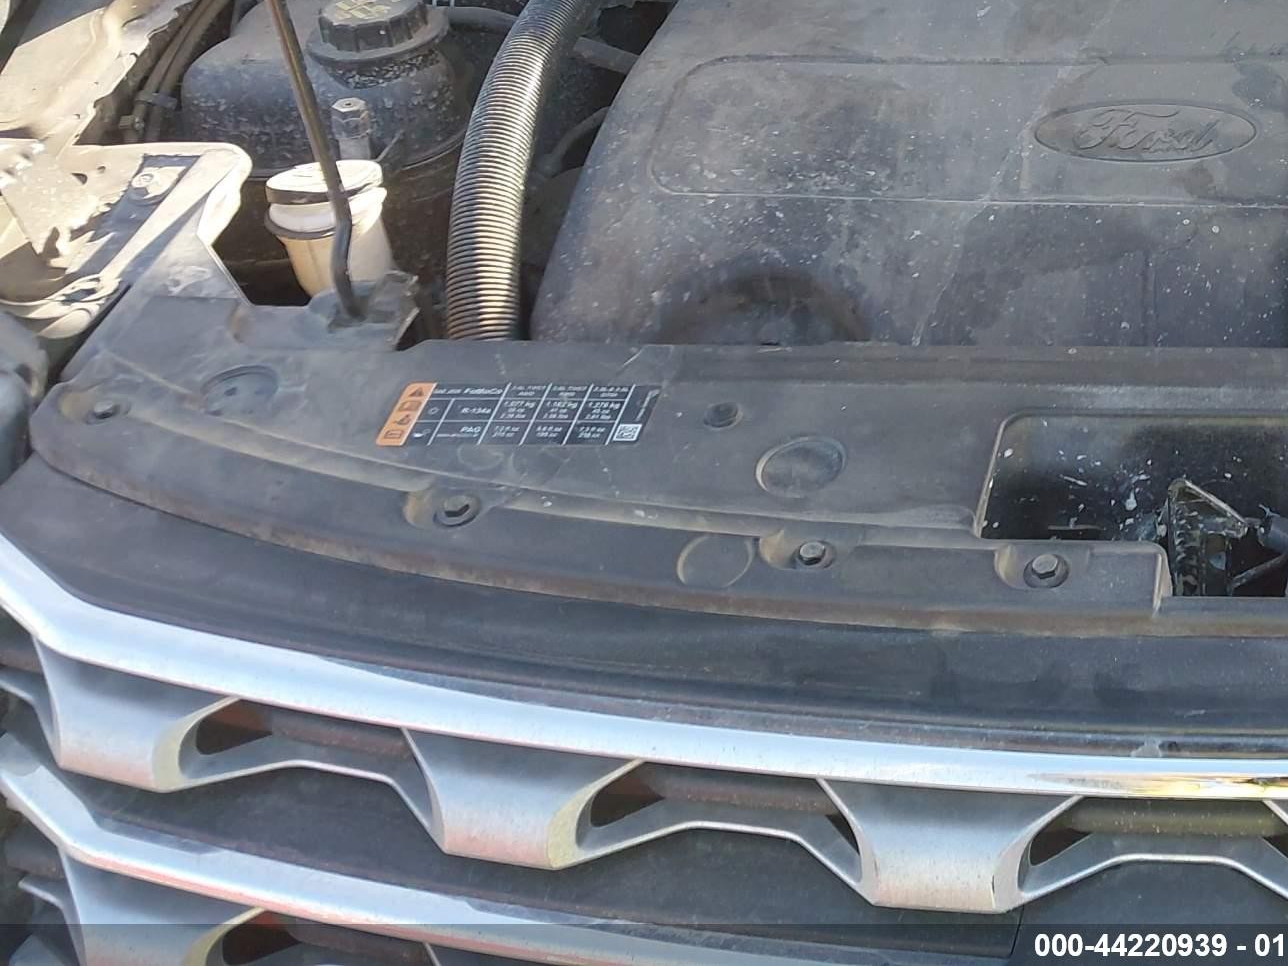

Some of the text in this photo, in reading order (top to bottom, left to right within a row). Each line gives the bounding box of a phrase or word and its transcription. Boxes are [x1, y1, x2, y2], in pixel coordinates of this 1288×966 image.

[1072, 108, 1220, 153] Ford
[461, 406, 492, 414] R-134a
[460, 425, 482, 433] PAG
